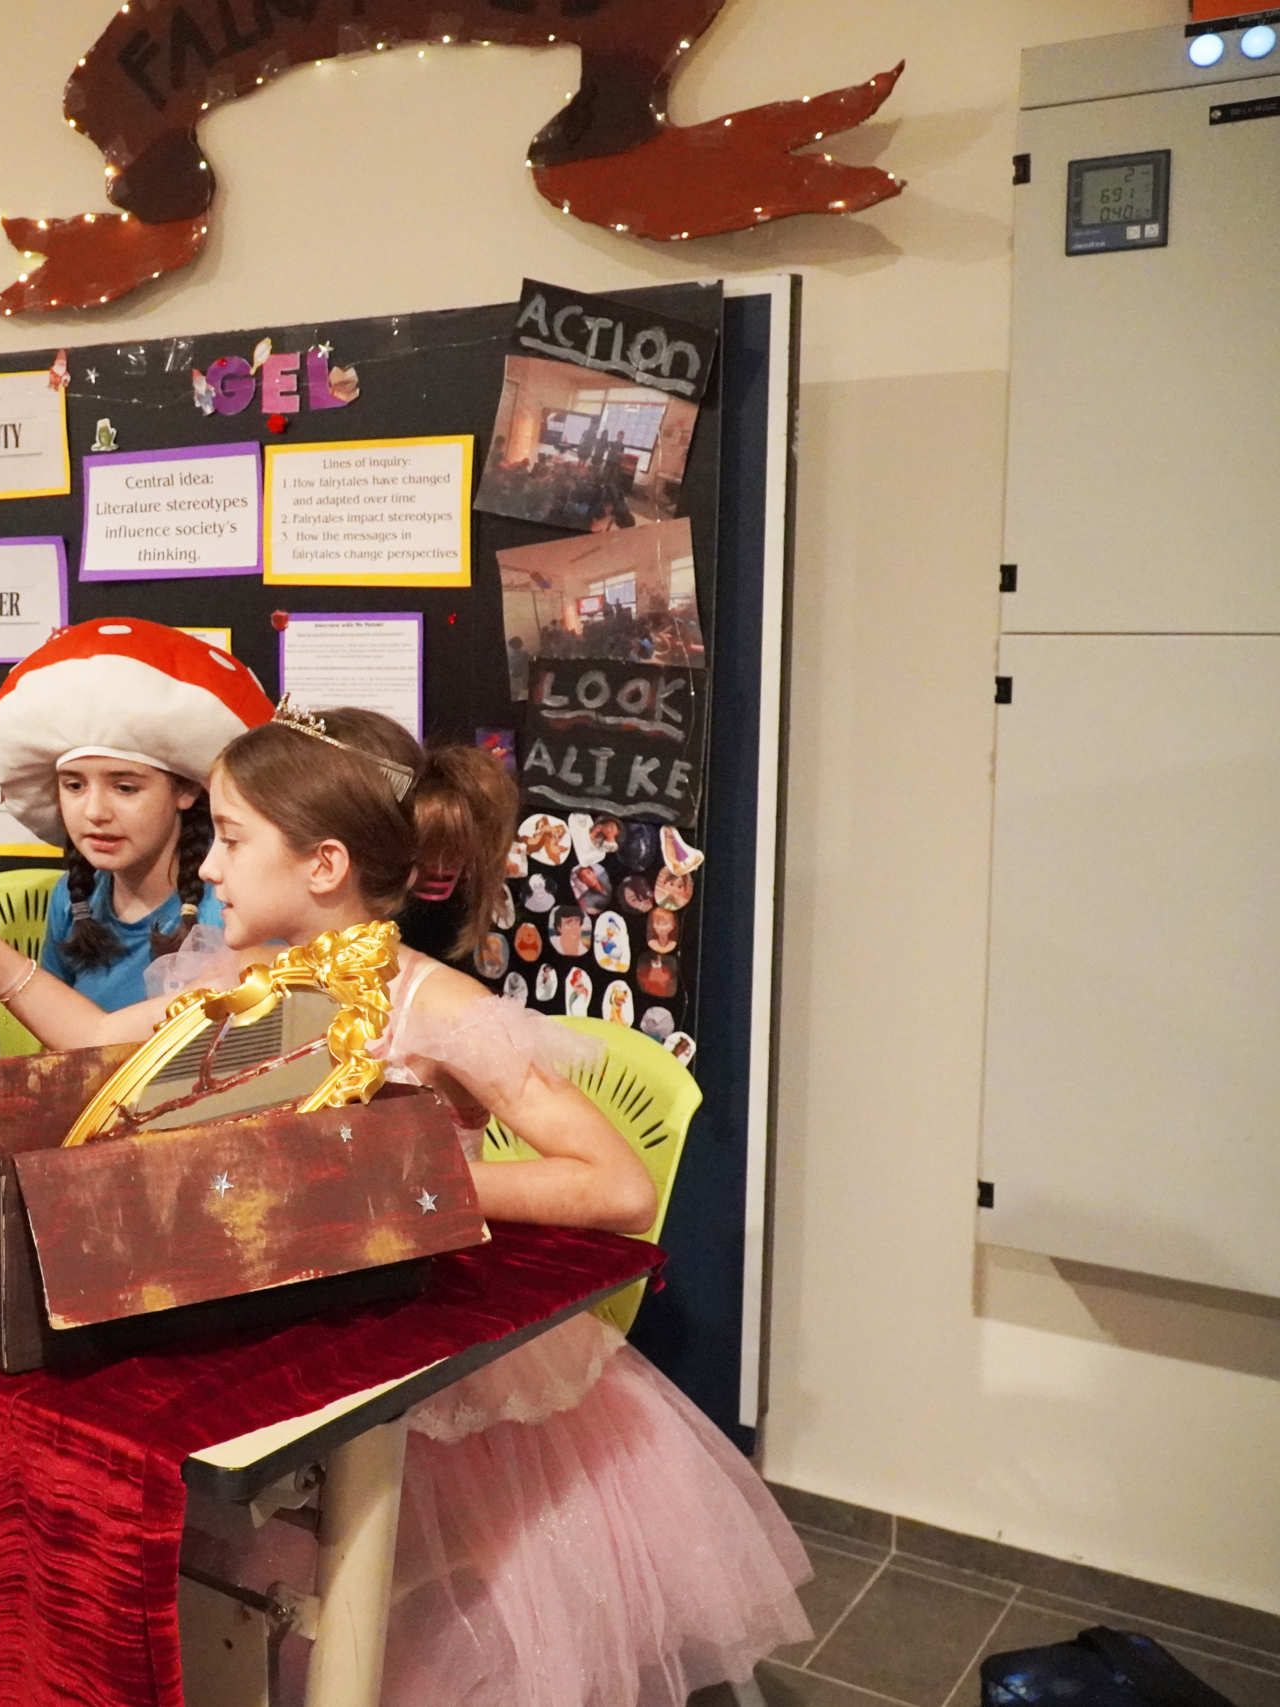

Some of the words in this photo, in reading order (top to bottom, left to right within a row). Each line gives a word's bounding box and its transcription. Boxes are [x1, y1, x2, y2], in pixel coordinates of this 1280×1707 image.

[206, 347, 350, 416] GEL
[323, 458, 351, 470] Lines
[355, 457, 366, 468] of
[370, 456, 411, 469] inquiry:
[125, 474, 174, 489] Central
[180, 473, 214, 486] idea:
[319, 476, 369, 490] fairytales
[372, 475, 398, 485] have
[402, 473, 451, 486] changed
[96, 501, 161, 516] Literature
[166, 496, 248, 513] stereotypes
[293, 496, 313, 506] and
[316, 494, 360, 507] adapted
[363, 494, 387, 504] over
[391, 493, 416, 504] time
[347, 512, 384, 524] impact
[388, 511, 452, 524] stereotypes
[105, 524, 170, 539] influence
[175, 521, 237, 538] society's
[296, 532, 319, 541] How
[322, 531, 340, 540] the
[343, 532, 397, 544] messages
[401, 530, 411, 540] in
[138, 547, 200, 564] thinking.
[292, 549, 341, 562] fairytales
[344, 549, 383, 562] change
[387, 547, 458, 561] perspectives
[540, 667, 687, 724] LOOK
[523, 737, 693, 800] ALIKE
